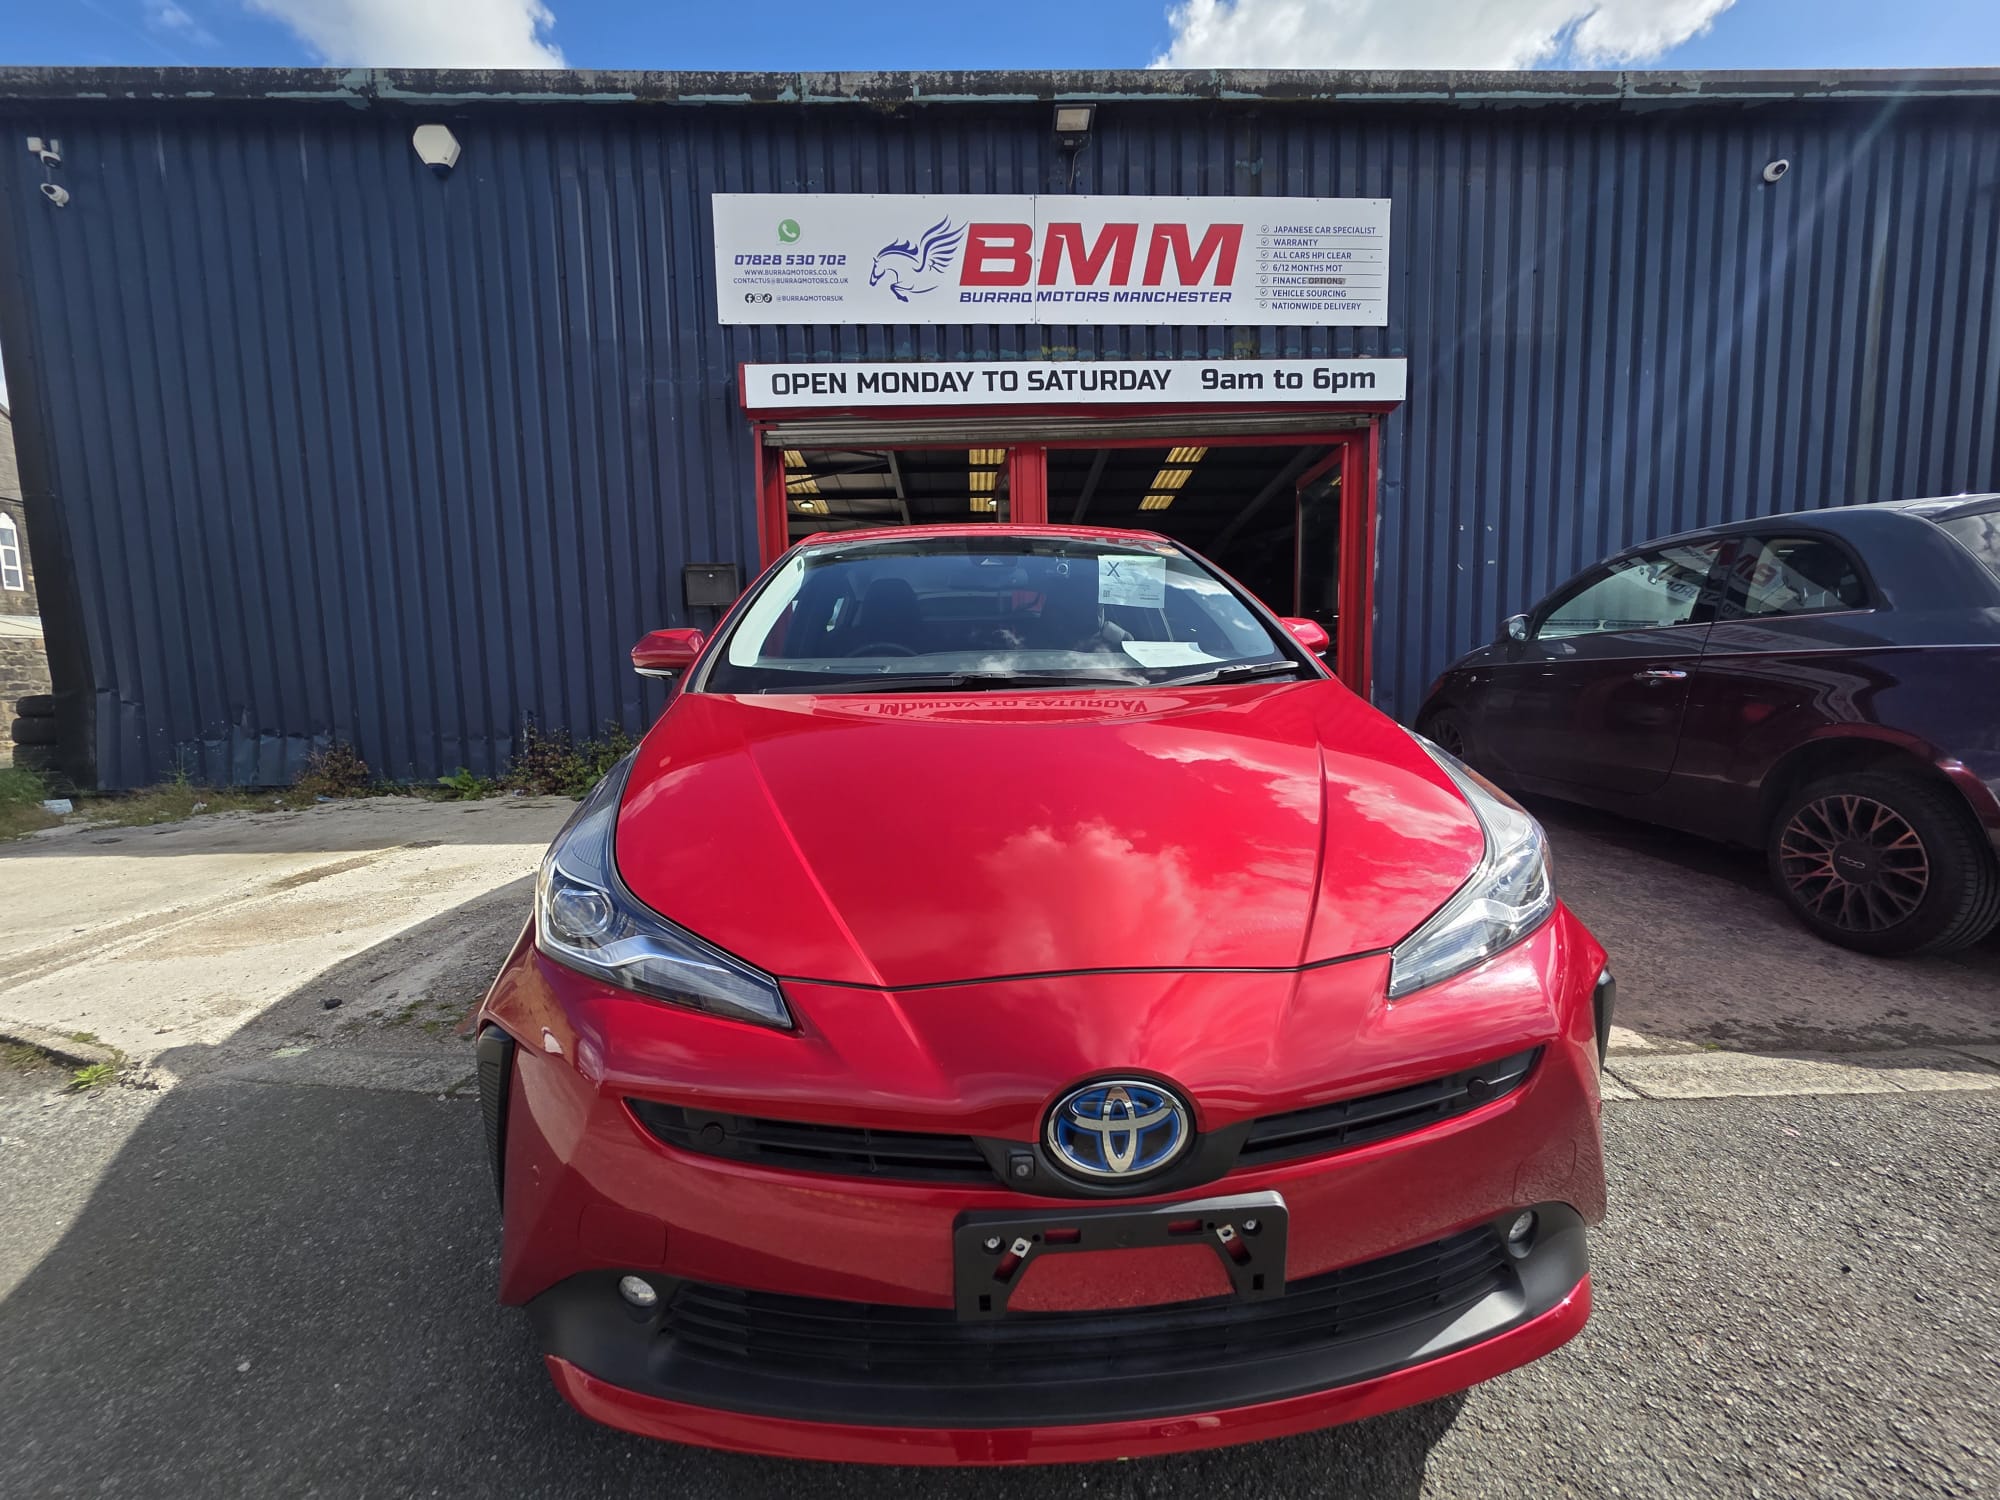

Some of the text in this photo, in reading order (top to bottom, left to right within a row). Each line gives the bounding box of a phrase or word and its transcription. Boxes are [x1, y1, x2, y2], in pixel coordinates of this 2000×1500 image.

[1273, 226, 1376, 235] JAPANESE CAR SPECIALIST
[1273, 239, 1319, 247] WARRANTY
[959, 222, 1243, 286] BMM
[1272, 251, 1352, 260] ALL CARS HPI CLEAR
[734, 254, 847, 266] 07828 530 702
[1272, 264, 1343, 272] 6/12 MONTHS MOT
[960, 291, 1232, 303] BURRAQ MOTORS MANCHESTER
[1272, 290, 1347, 298] VEHICLE SOURCING
[1271, 302, 1362, 311] NATIONWIDE DELIVERY
[771, 367, 1376, 395] OPEN MONDAY TO SATURDAY 9am to 6pm
